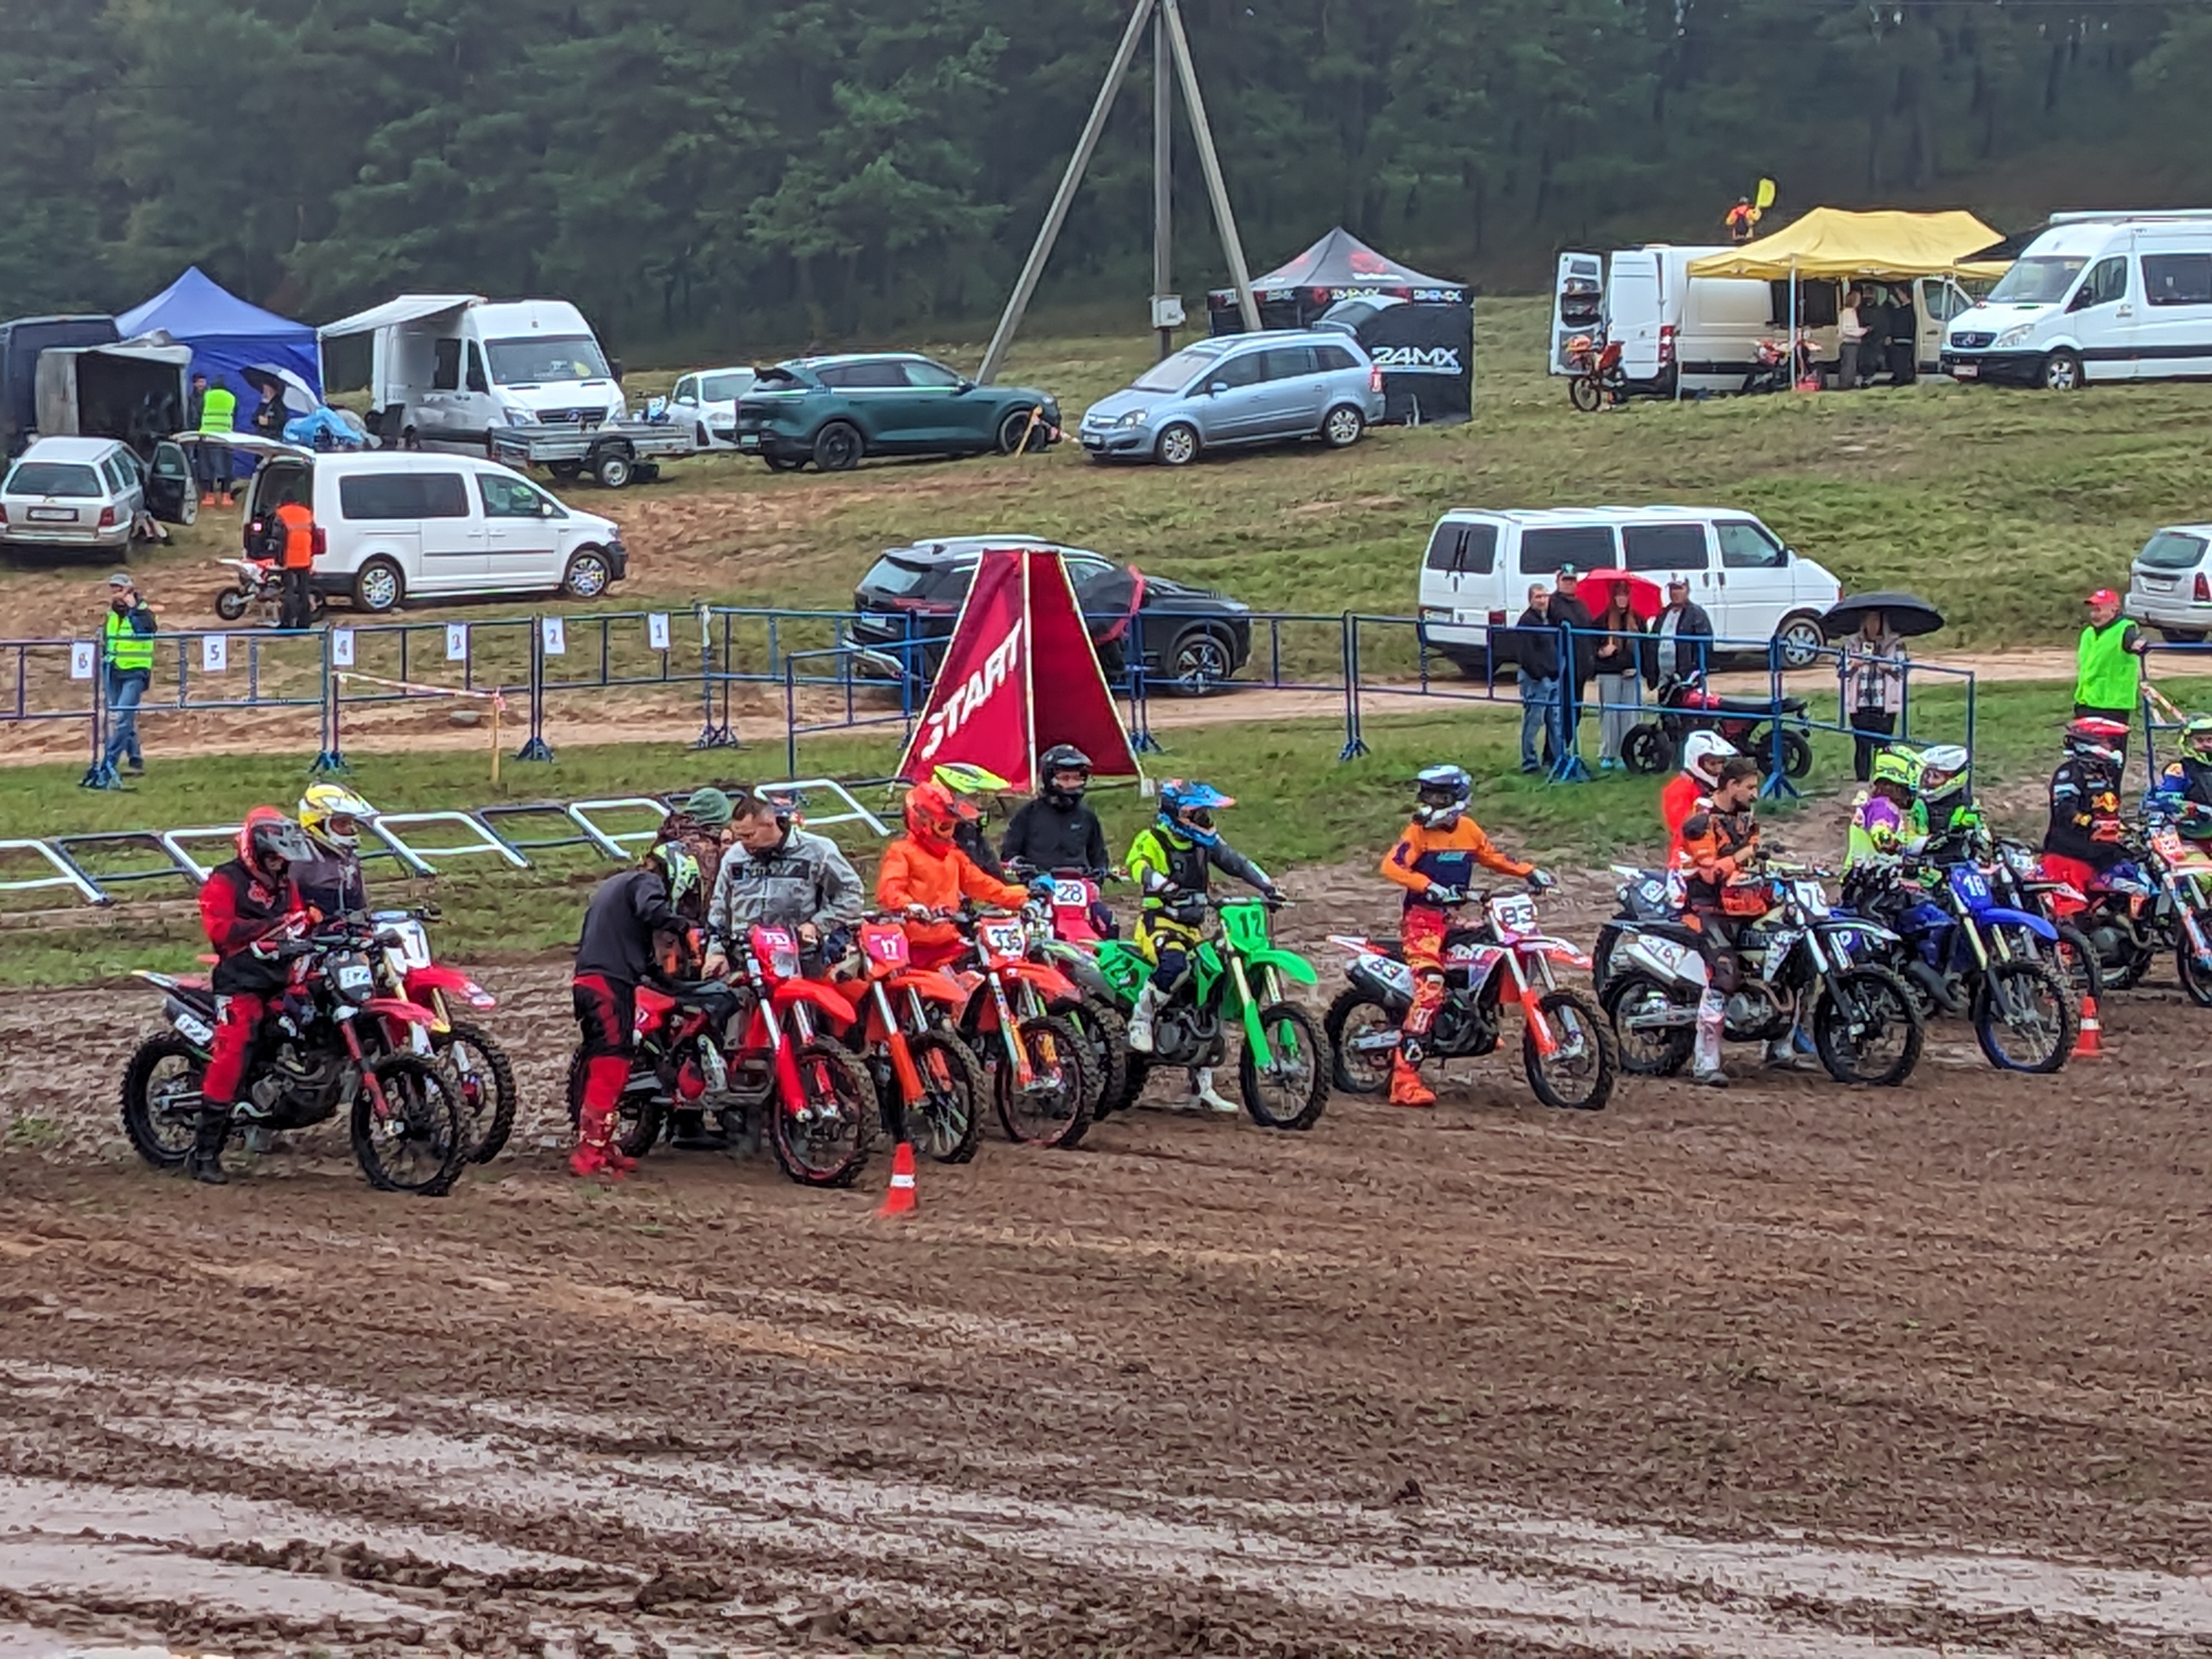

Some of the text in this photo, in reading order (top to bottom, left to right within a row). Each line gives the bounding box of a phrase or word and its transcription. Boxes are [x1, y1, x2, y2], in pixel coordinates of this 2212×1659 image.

[550, 628, 558, 644] 2
[78, 652, 87, 670] 6
[210, 644, 220, 661] 5
[1057, 882, 1083, 903] 28
[1499, 903, 1534, 926] 83
